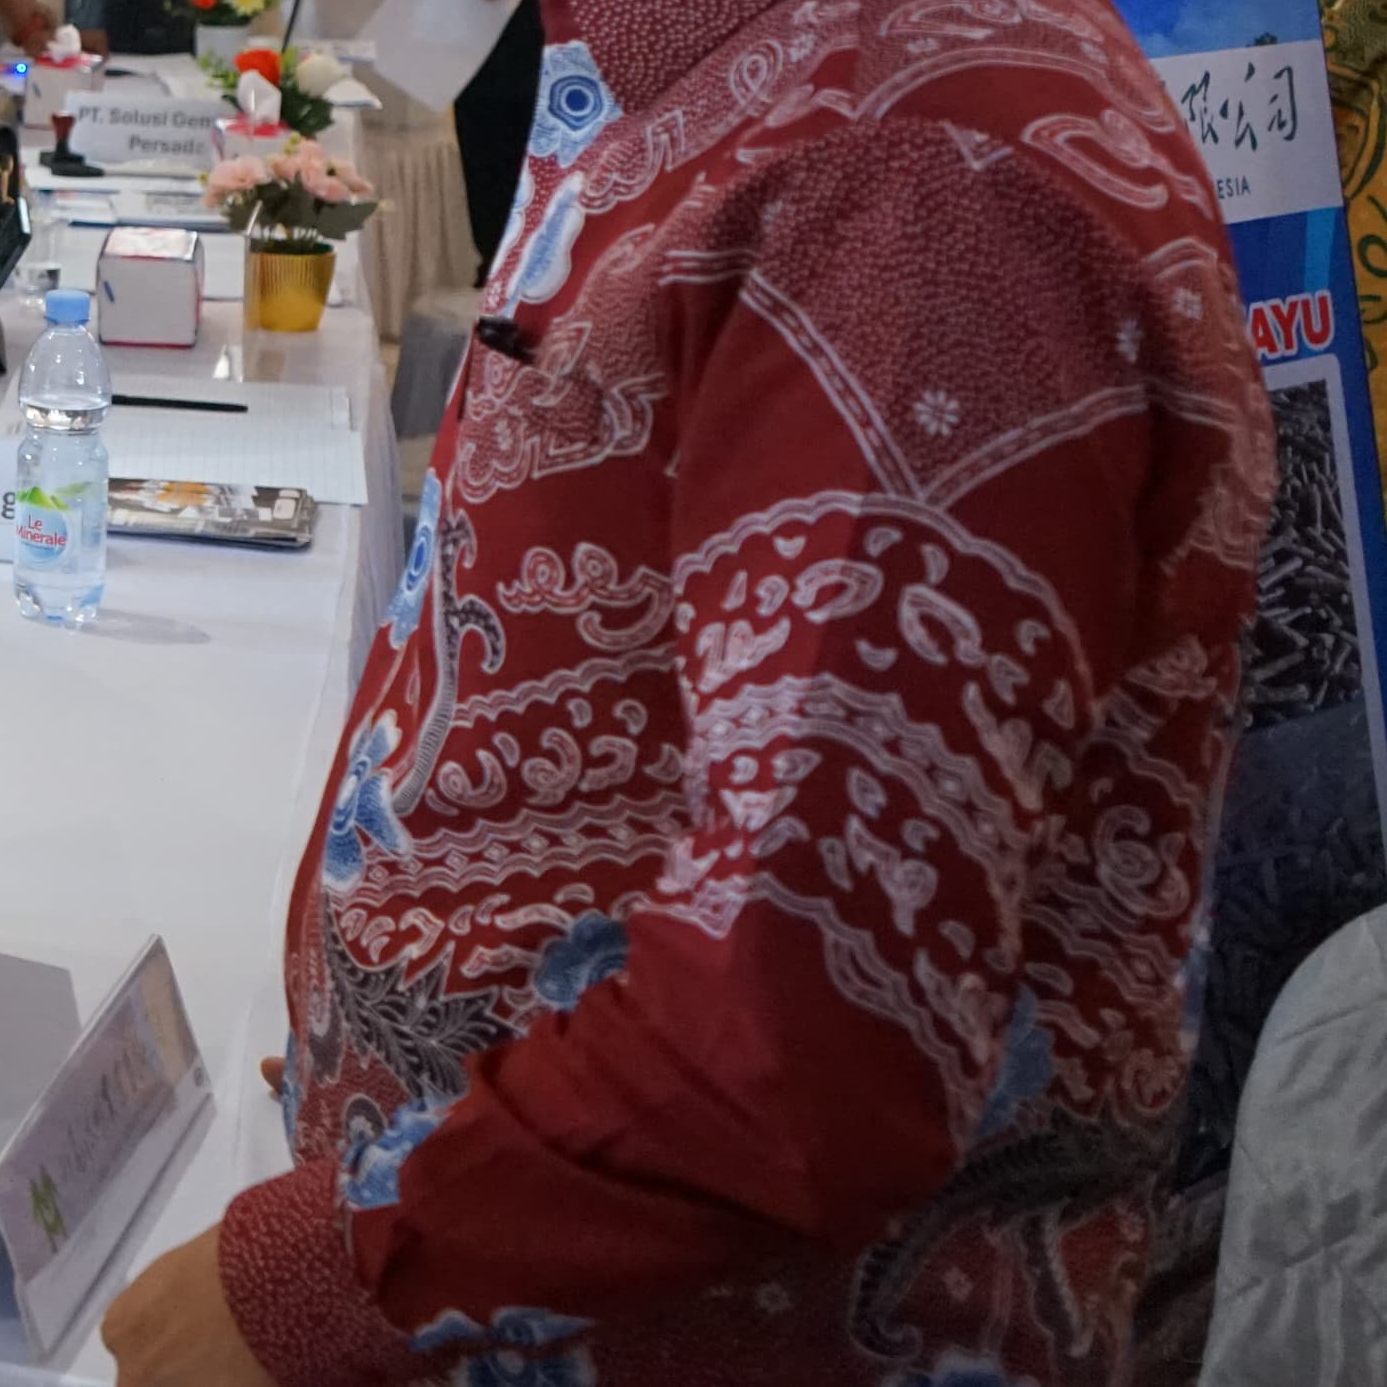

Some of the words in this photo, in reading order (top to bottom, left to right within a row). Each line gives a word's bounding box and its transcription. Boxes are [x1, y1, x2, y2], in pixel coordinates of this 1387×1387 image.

[78, 106, 104, 124] PT.
[109, 107, 168, 128] Solusi
[1175, 62, 1298, 152] 限公司
[1216, 176, 1250, 199] ESIA
[1249, 294, 1333, 356] AYU
[28, 513, 43, 531] Le
